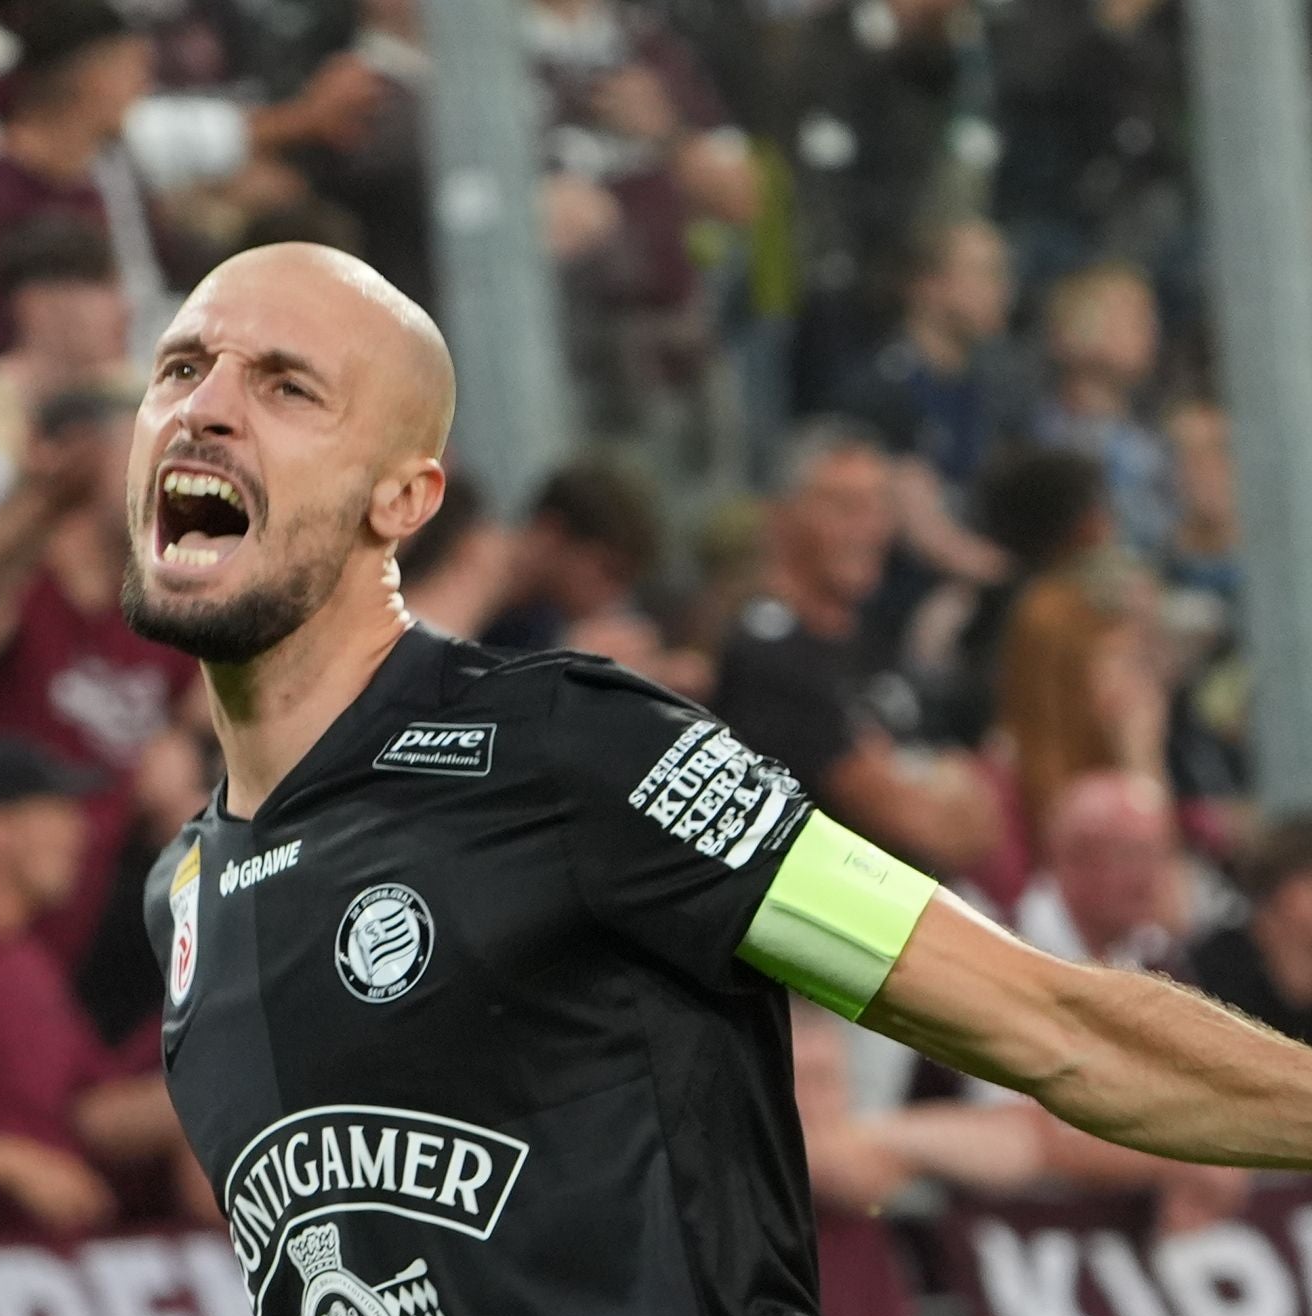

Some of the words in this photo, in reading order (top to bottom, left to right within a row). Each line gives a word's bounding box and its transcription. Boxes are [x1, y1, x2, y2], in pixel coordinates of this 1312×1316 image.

[390, 730, 486, 752] pure
[239, 839, 303, 890] GRAWE
[230, 1124, 494, 1275] UNTIGAMER
